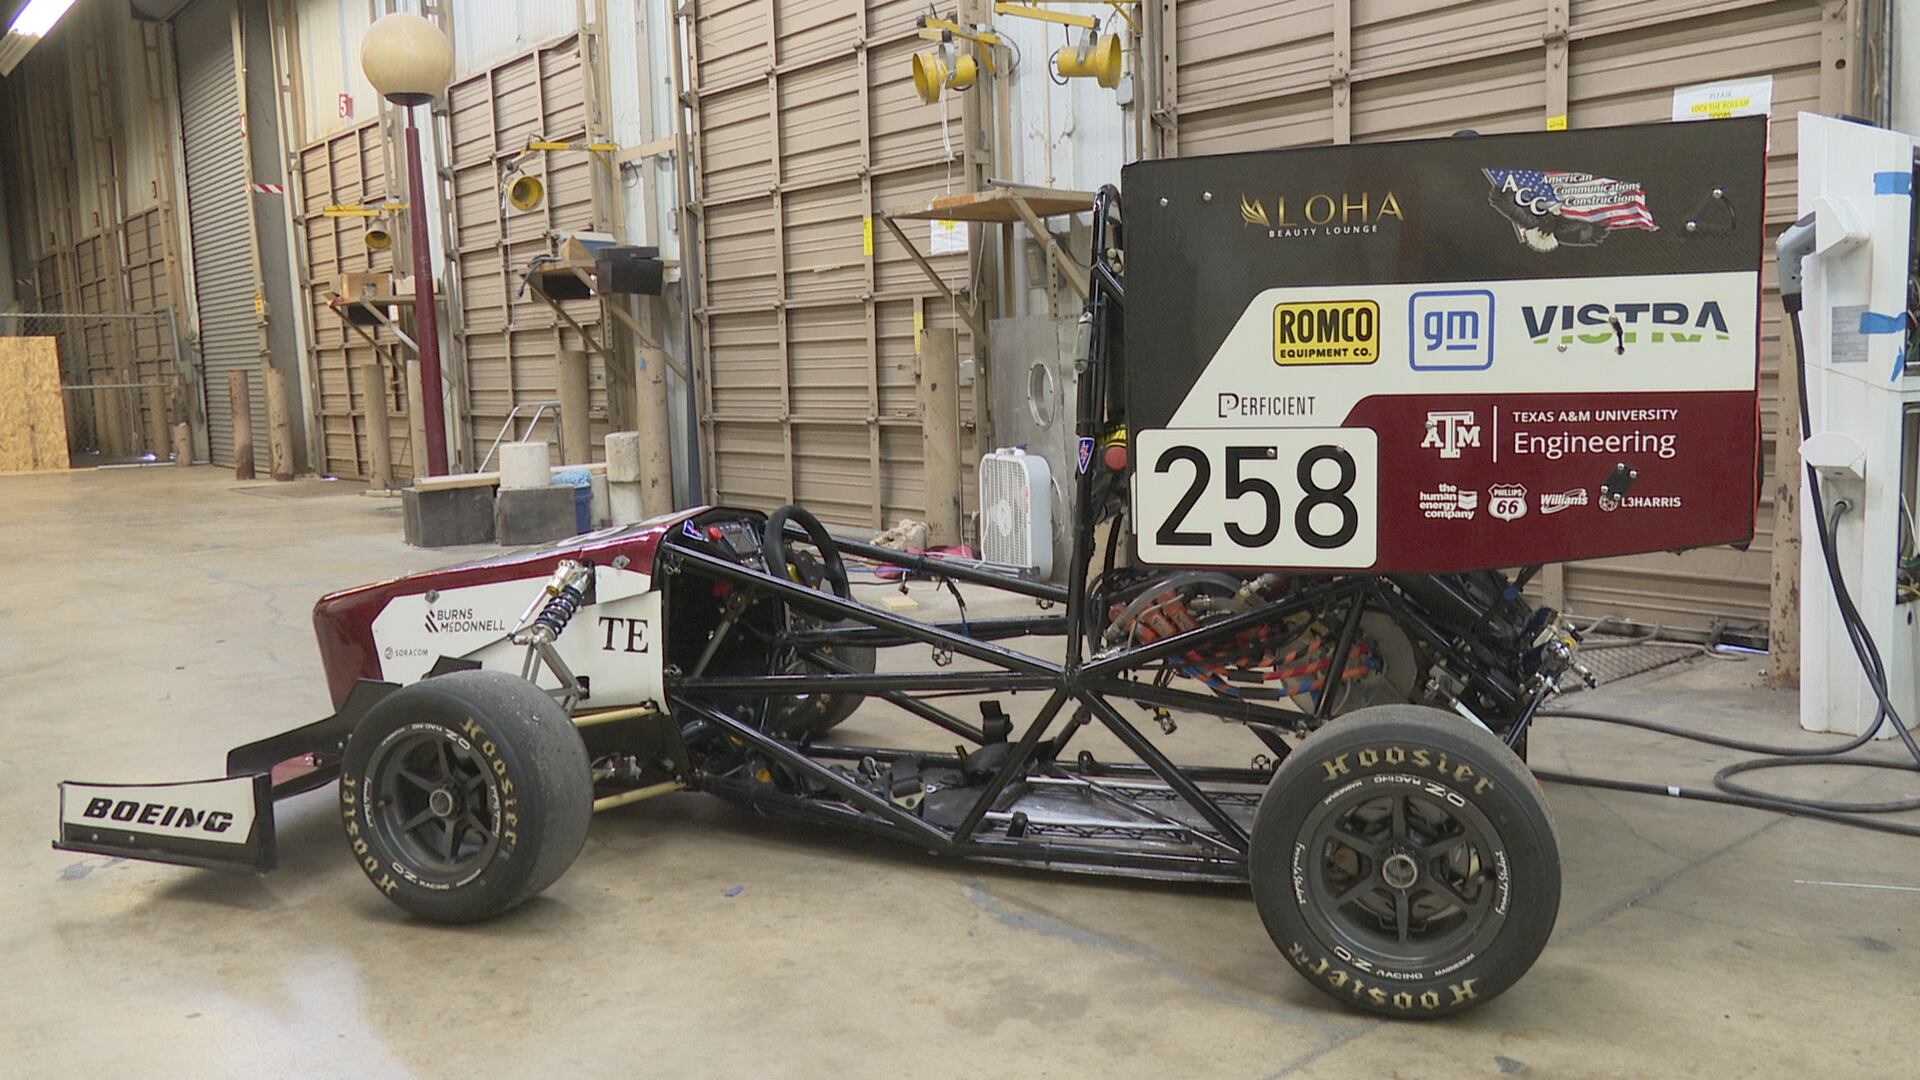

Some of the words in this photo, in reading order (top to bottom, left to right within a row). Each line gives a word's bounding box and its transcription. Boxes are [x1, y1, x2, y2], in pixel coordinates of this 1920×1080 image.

[339, 96, 348, 117] 5
[1541, 173, 1593, 184] American
[1553, 181, 1641, 195] Communications
[1241, 191, 1404, 228] ALOHA
[1269, 228, 1317, 238] BEAUTY
[1326, 225, 1378, 235] LOUNGE
[1280, 307, 1373, 345] ROMCO
[1522, 301, 1730, 343] VISTRA
[1424, 310, 1479, 351] gm
[1280, 348, 1349, 359] EQUIPMENT
[1353, 347, 1373, 358] CO.
[1218, 393, 1316, 418] PERFICIENT
[1513, 411, 1554, 423] TEXAS
[1558, 410, 1590, 422] A&M
[1595, 409, 1679, 421] UNIVERSITY
[1514, 430, 1676, 459] Engineering
[1438, 483, 1457, 493] the
[1493, 489, 1523, 497] PHILLIPS
[1154, 445, 1359, 549] 258
[1420, 492, 1457, 501] human
[1540, 493, 1588, 507] Williams
[1621, 497, 1681, 508] L3HARRIS
[1419, 501, 1457, 512] energy
[1496, 501, 1519, 515] 66
[1424, 509, 1475, 520] company
[437, 608, 473, 620] BURNS
[598, 617, 649, 654] TE
[395, 649, 428, 657] SORACOM
[1321, 746, 1495, 795] Hoosier
[459, 716, 518, 846] Hoosier
[1373, 776, 1422, 786] RACING
[83, 797, 233, 833] BOEING
[343, 773, 399, 893] Hoosier
[1308, 957, 1479, 1010] Hoosier
